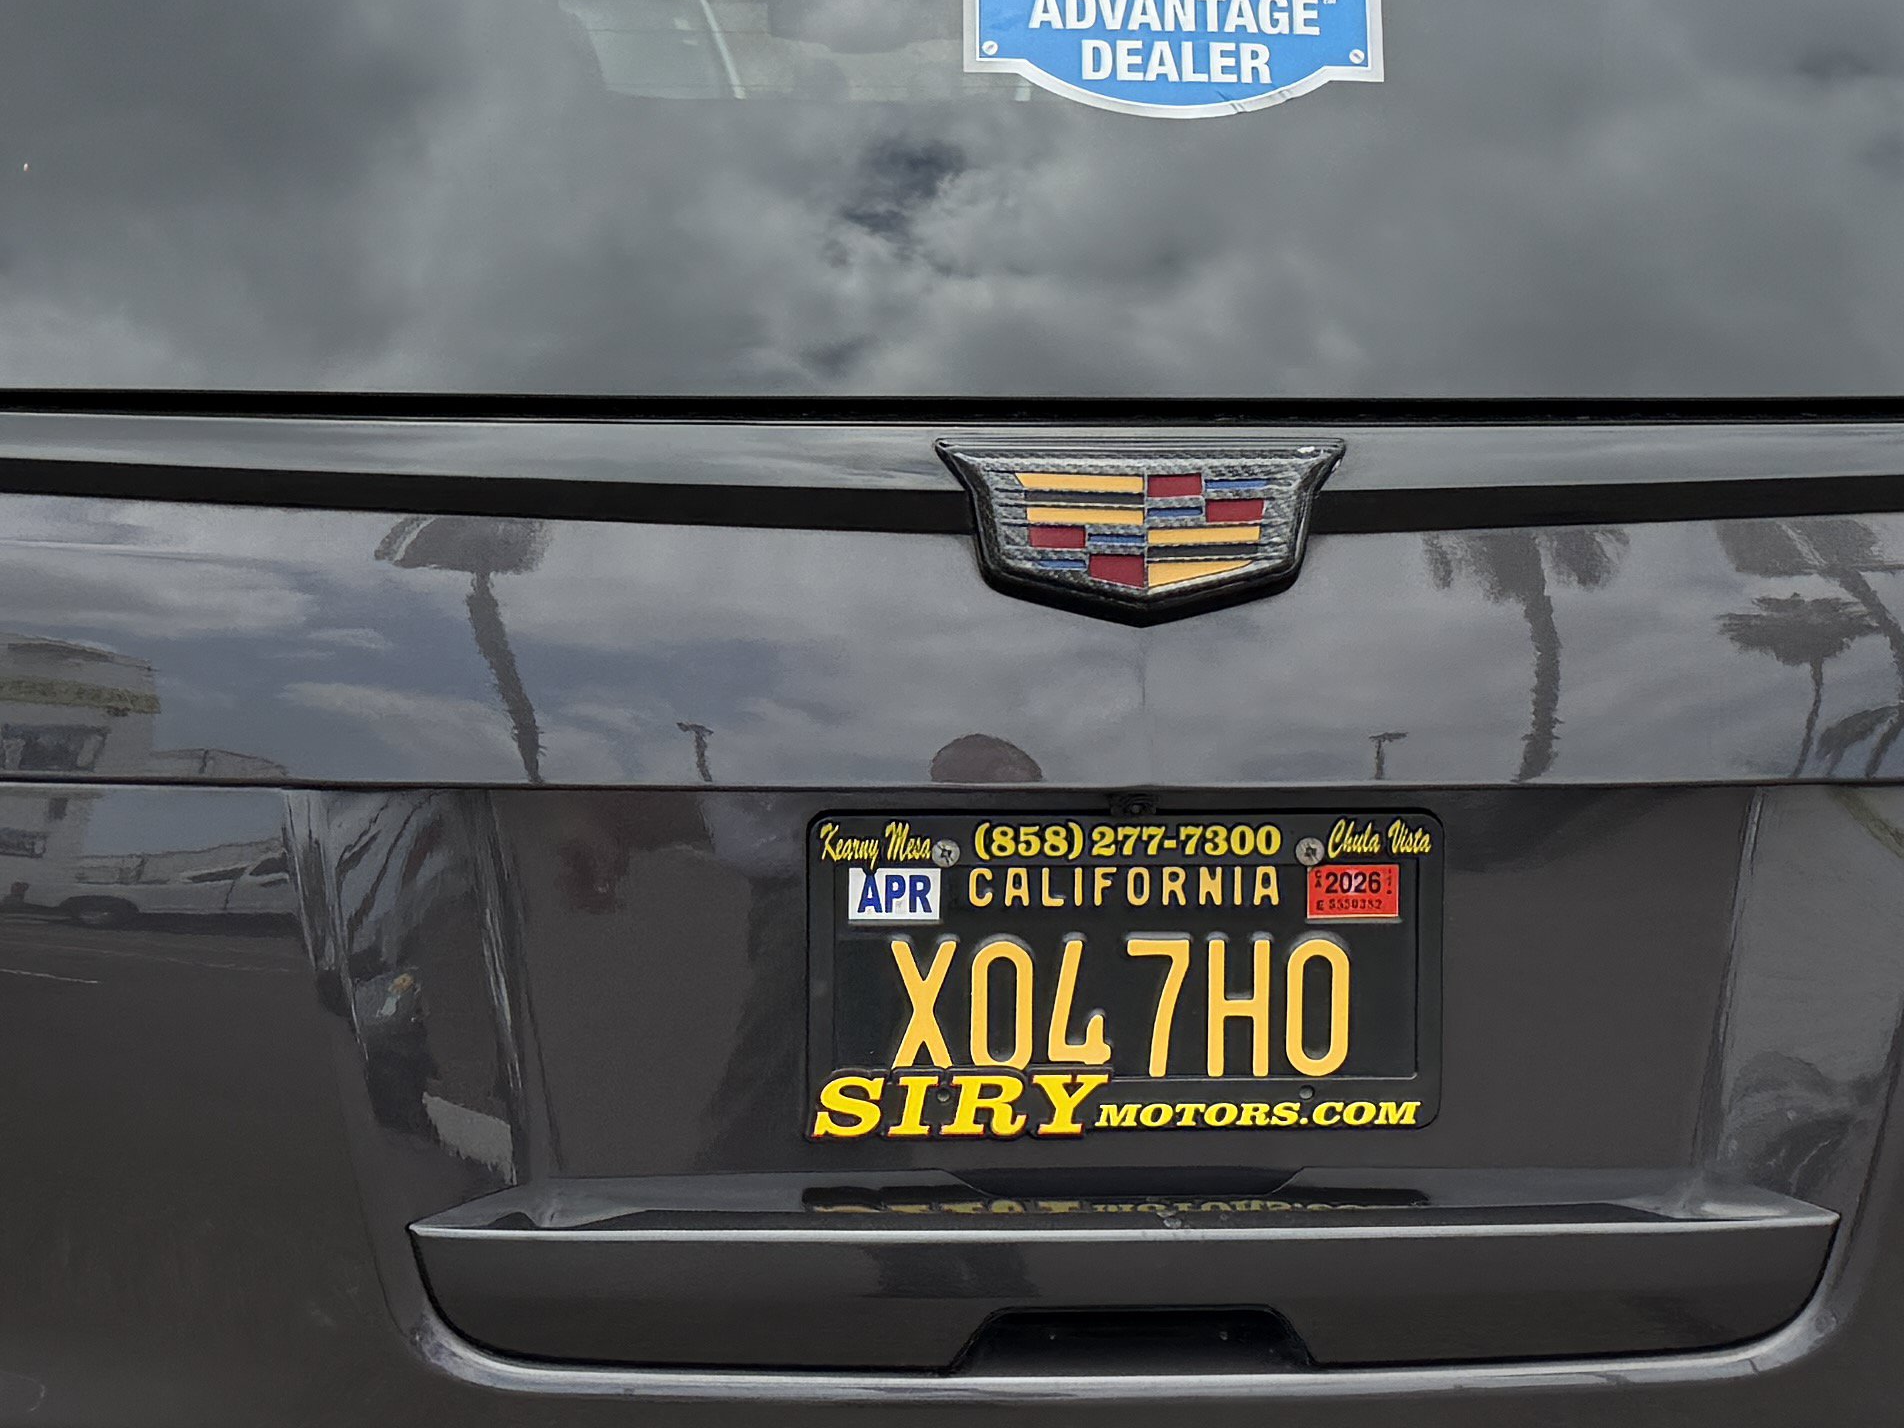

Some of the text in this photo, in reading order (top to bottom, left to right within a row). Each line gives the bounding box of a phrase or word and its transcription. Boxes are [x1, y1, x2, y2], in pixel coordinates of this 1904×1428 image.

[1081, 39, 1273, 84] DEALER
[820, 821, 933, 870] Kearny Mesa
[974, 821, 1282, 861] (858) 277-7300
[1326, 818, 1433, 860] Chula Vista
[856, 870, 933, 913] APR
[968, 866, 1280, 908] CALIFORNIA
[1324, 870, 1382, 894] 2026
